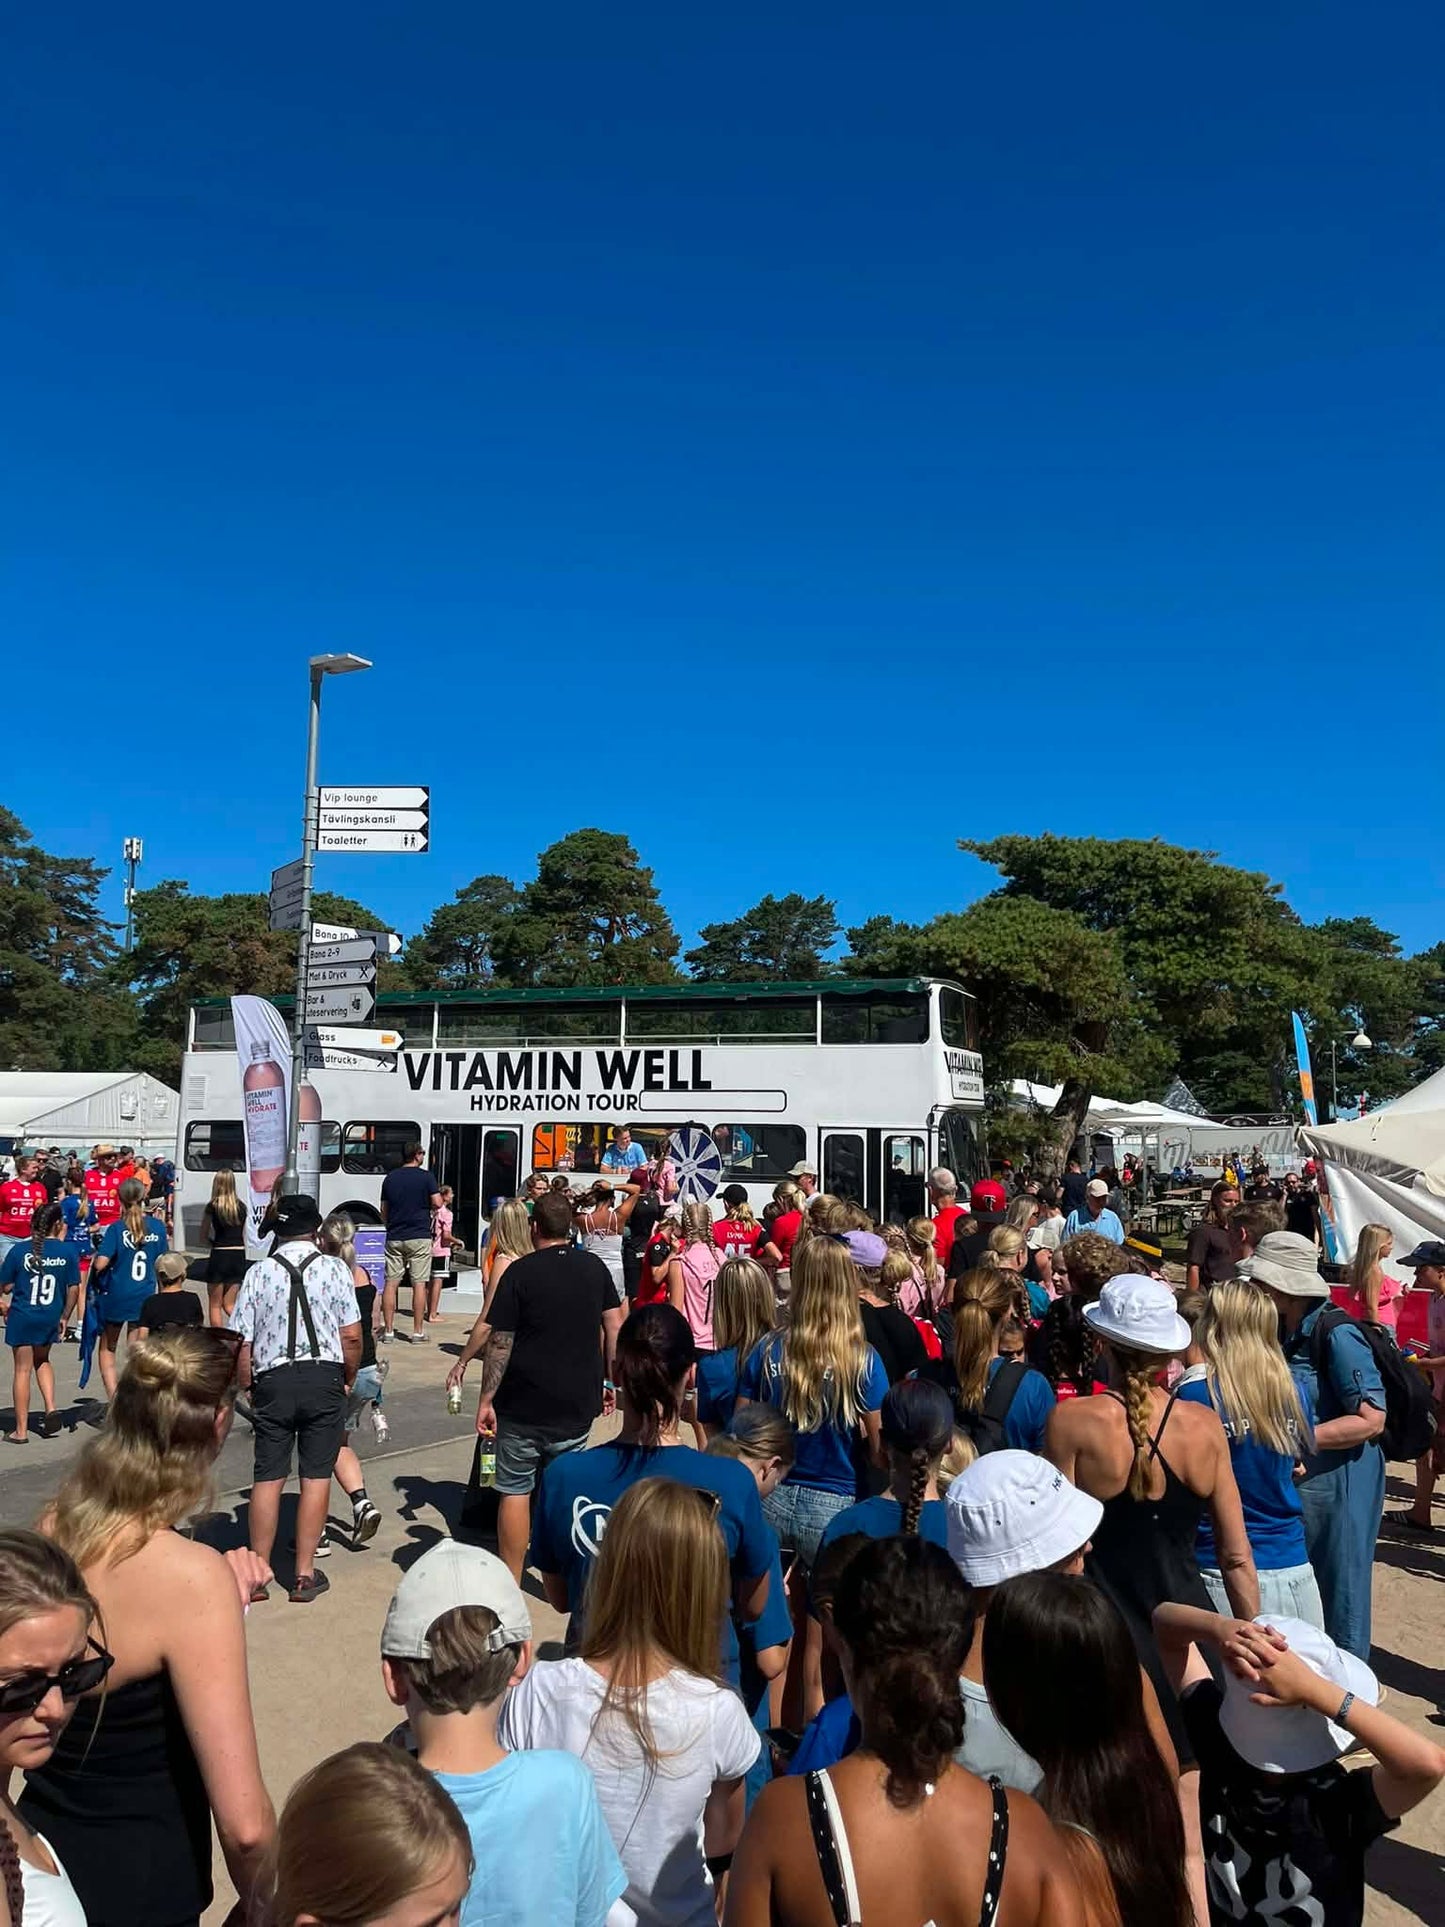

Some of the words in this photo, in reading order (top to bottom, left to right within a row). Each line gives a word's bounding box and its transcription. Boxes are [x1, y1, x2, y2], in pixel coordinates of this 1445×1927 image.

[324, 793, 341, 803] Vip
[344, 793, 378, 804] lounge
[322, 814, 396, 825] Tävlingskansli
[322, 836, 368, 845] Toaletter
[315, 928, 337, 939] Bana
[309, 950, 326, 959] Bana
[327, 947, 340, 958] 2-9
[309, 972, 318, 981] Mat
[328, 970, 347, 980] Dryck
[307, 995, 319, 1005] Bar
[309, 1032, 336, 1041] Glass
[308, 1053, 358, 1065] Foodtrucks
[403, 1051, 582, 1091] VITAMIN
[595, 1050, 712, 1090] WELL
[470, 1094, 580, 1111] HYDRATION
[586, 1094, 638, 1111] TOUR
[10, 1207, 35, 1216] CEA
[131, 1250, 147, 1282] 6
[29, 1273, 56, 1306] 19
